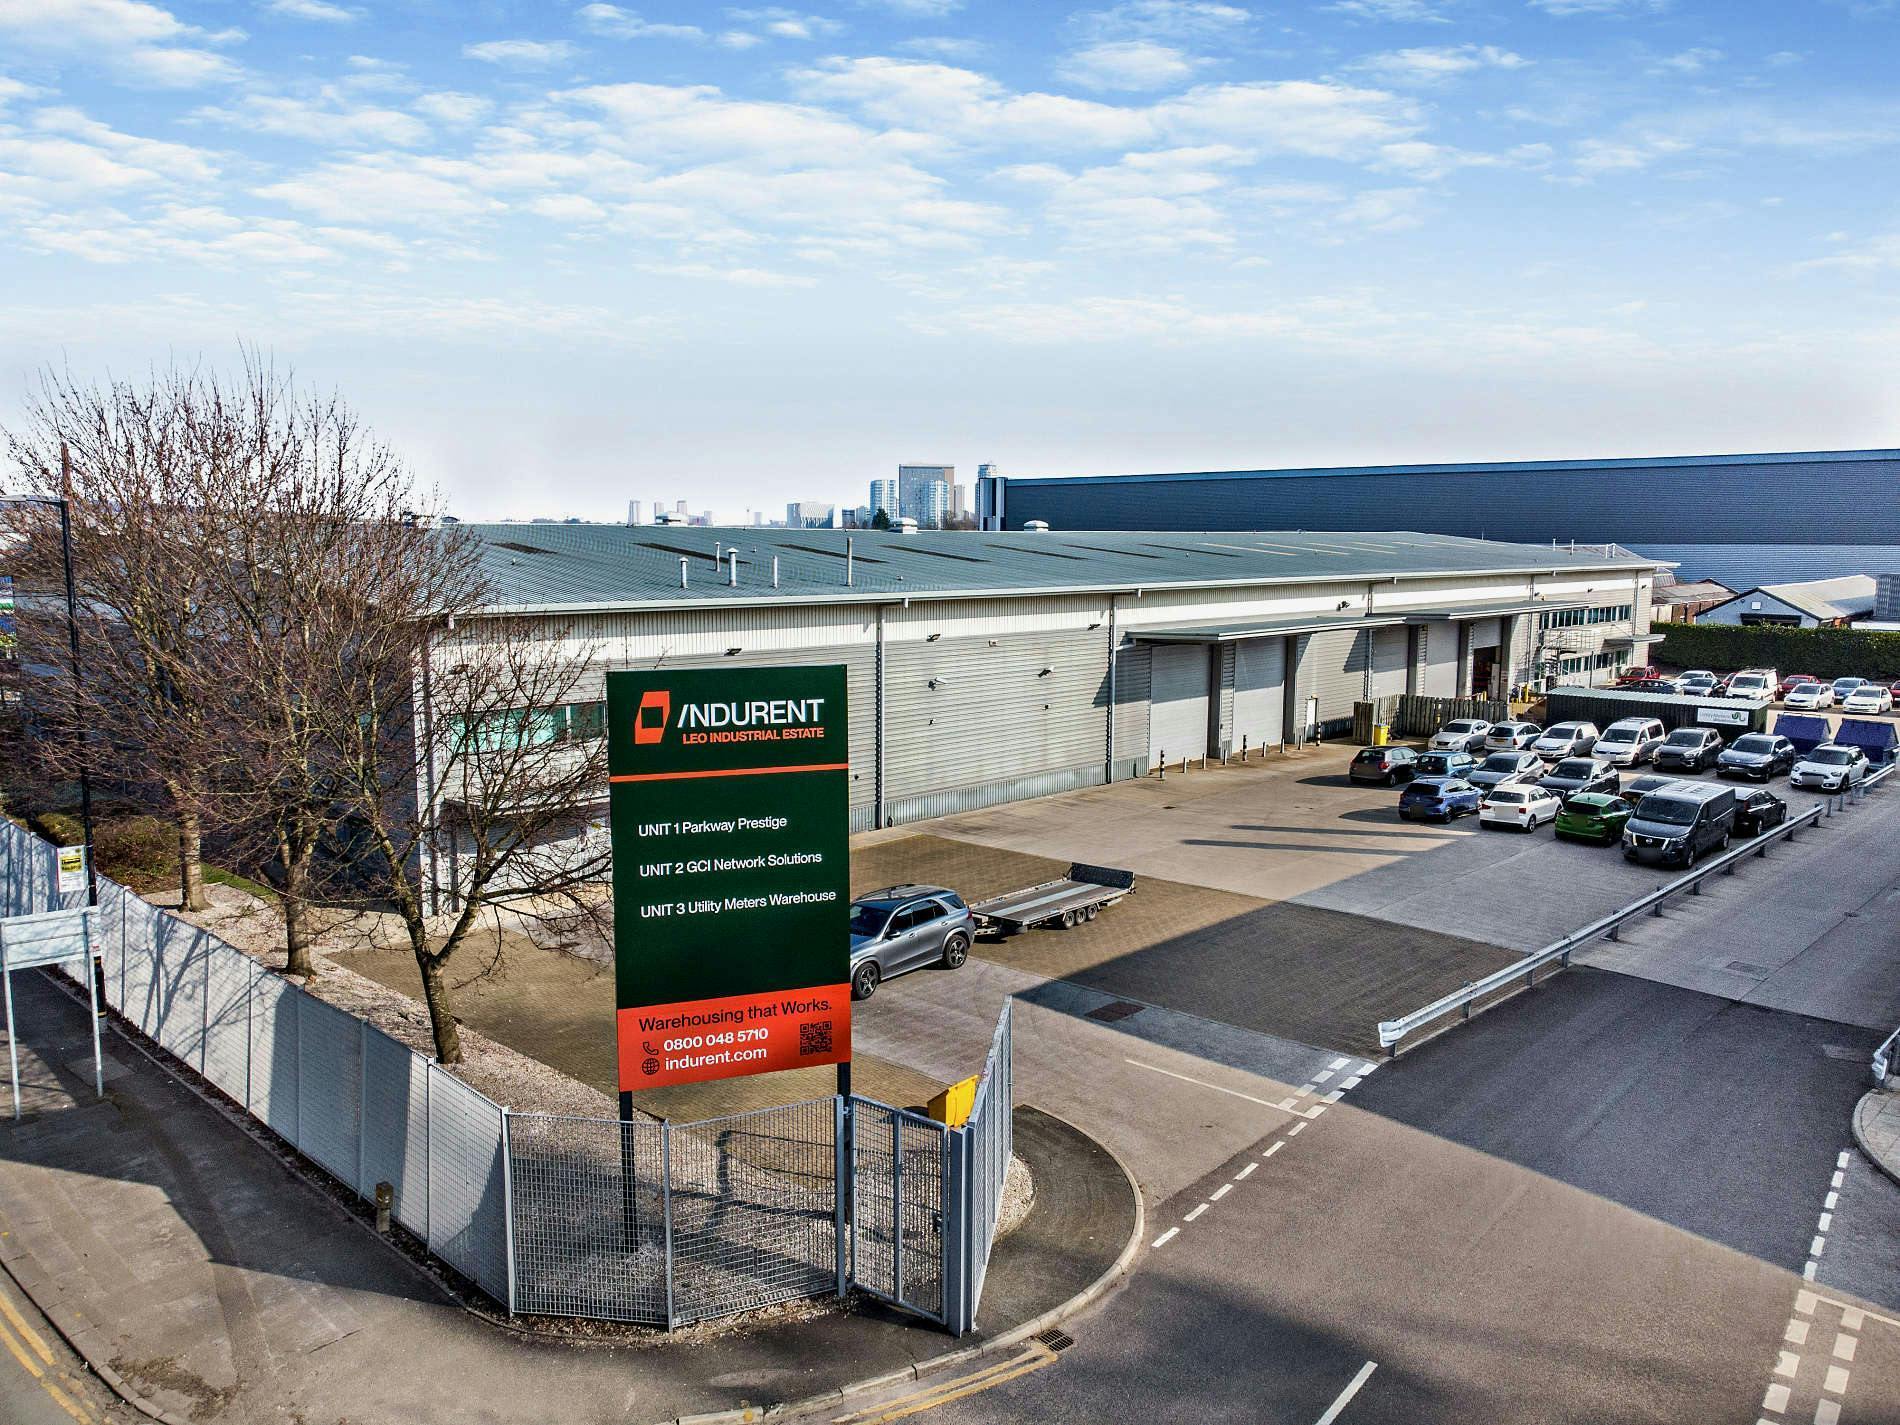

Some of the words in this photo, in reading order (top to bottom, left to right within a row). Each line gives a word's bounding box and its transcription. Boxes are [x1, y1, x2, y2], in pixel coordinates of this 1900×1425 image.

[677, 698, 824, 728] INDURENT
[682, 732, 707, 745] LEO
[710, 729, 780, 743] INDUSTRIAL
[782, 727, 824, 739] ESTATE
[638, 822, 671, 837] UNIT
[674, 822, 680, 834] 1
[682, 819, 735, 834] Parkway
[738, 816, 787, 830] Prestige
[639, 862, 672, 877] UNIT
[675, 862, 684, 874] 2
[686, 860, 711, 873] GCI
[714, 855, 765, 871] Network
[767, 852, 822, 867] Solutions
[640, 903, 673, 918] UNIT
[676, 902, 685, 915] 3
[688, 899, 722, 914] Utility
[724, 896, 767, 911] Meters
[769, 890, 836, 906] Warehouse
[638, 1009, 744, 1032] Warehousing
[748, 1003, 778, 1019] that
[781, 998, 832, 1015] Works.
[663, 1036, 703, 1052] 0800
[705, 1031, 734, 1047] 048
[737, 1027, 769, 1043] 5710
[665, 1047, 767, 1071] indurent.com
